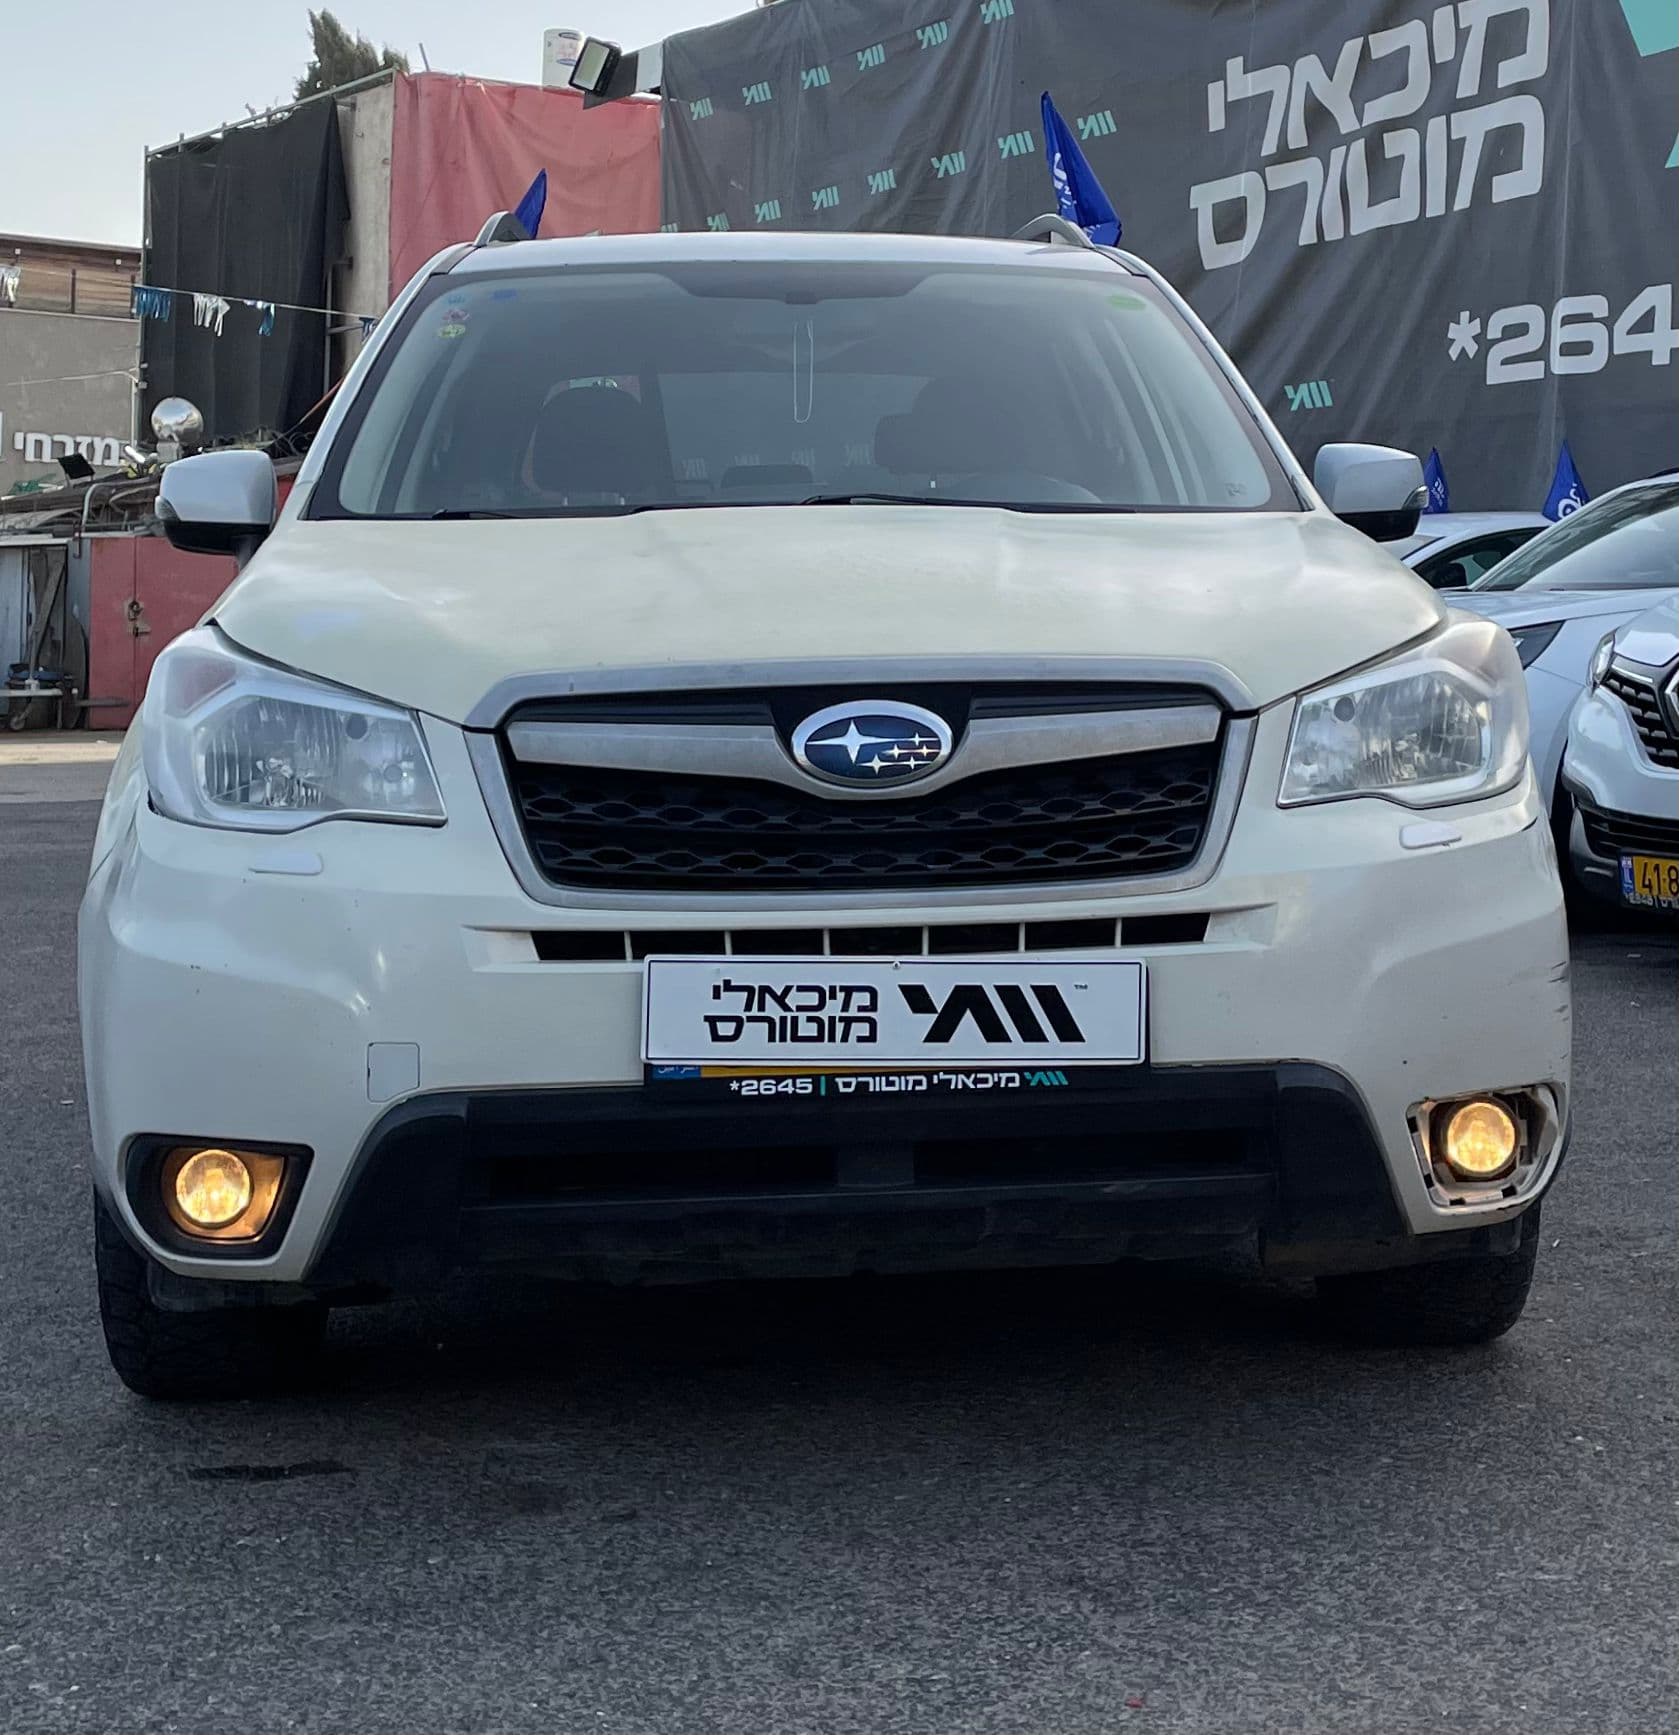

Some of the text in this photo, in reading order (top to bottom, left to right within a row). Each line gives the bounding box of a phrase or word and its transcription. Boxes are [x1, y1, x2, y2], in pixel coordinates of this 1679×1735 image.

[1207, 0, 1549, 157] מיכאלי
[1190, 94, 1545, 270] מוטורס
[13, 431, 120, 467] מזרחי
[712, 979, 878, 1012] מיכאלי
[703, 1014, 878, 1043] מוטורס
[834, 1075, 927, 1093] מוטורס
[932, 1071, 1021, 1090] מיכאלי
